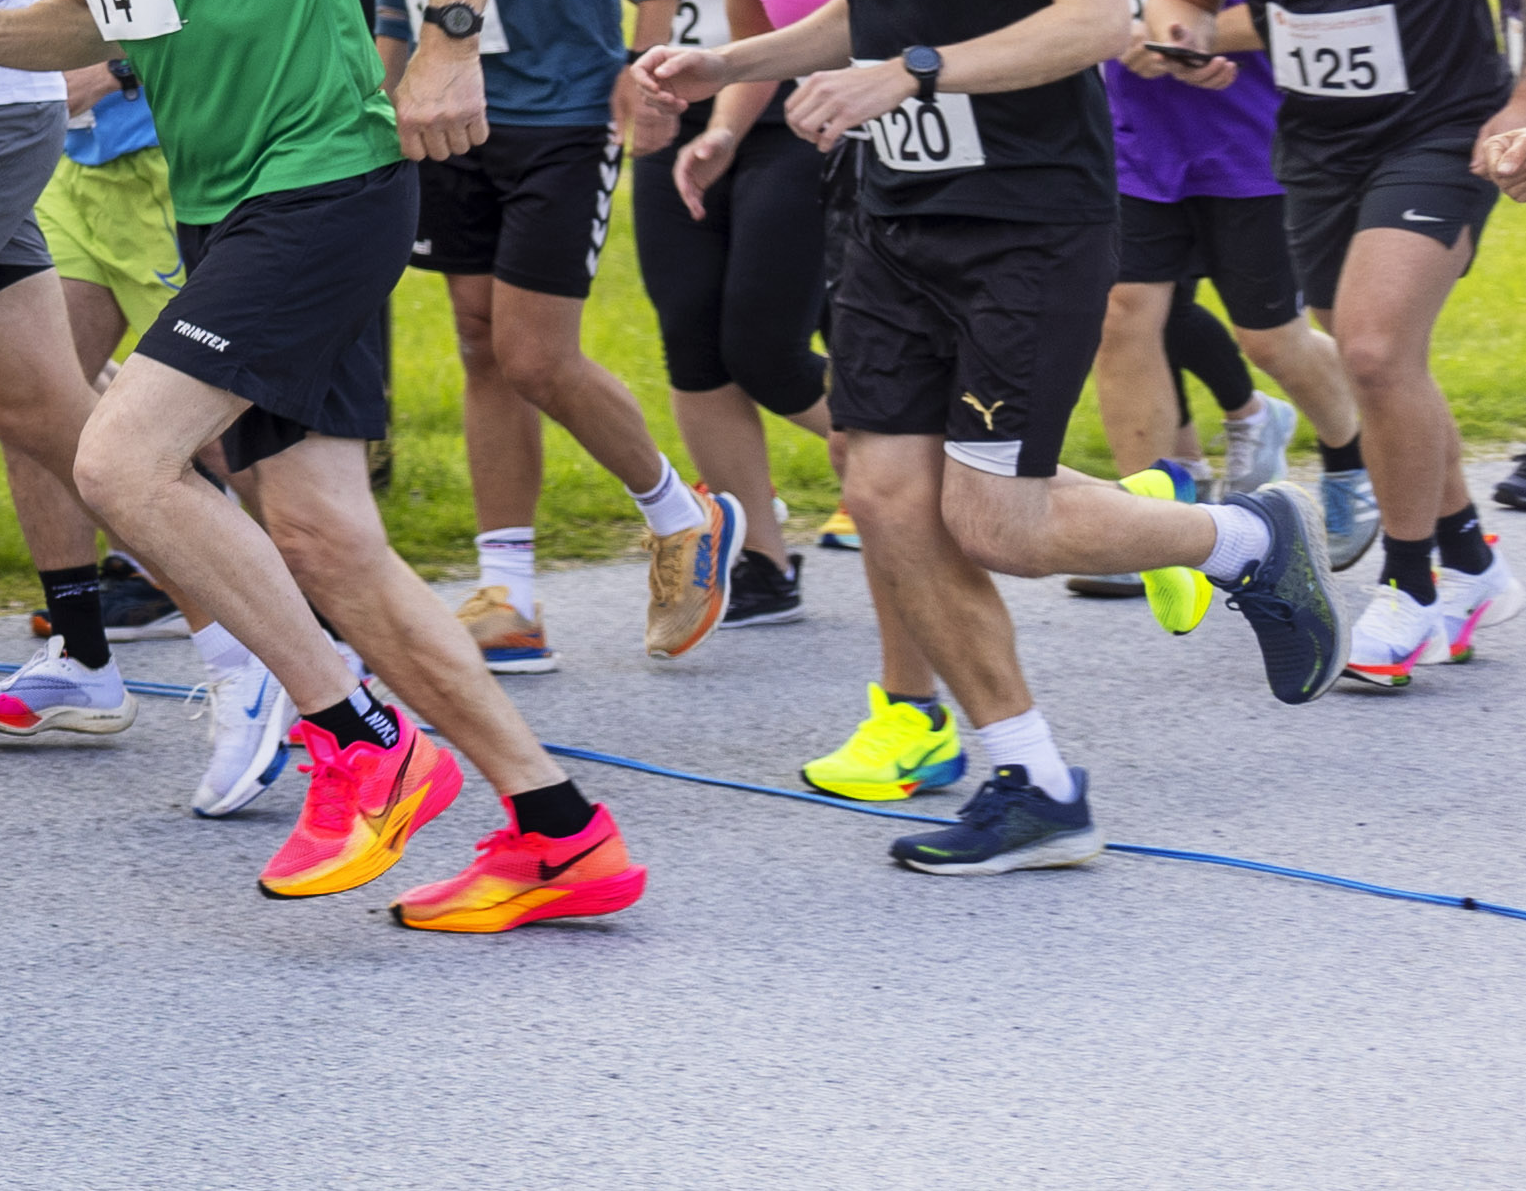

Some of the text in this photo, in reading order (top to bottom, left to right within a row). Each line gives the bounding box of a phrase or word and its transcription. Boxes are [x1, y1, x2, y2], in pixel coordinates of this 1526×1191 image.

[671, 1, 701, 45] 2
[1288, 45, 1378, 90] 125
[873, 103, 951, 162] 120
[172, 319, 232, 353] TRIMTEX
[364, 710, 399, 748] NIKE
